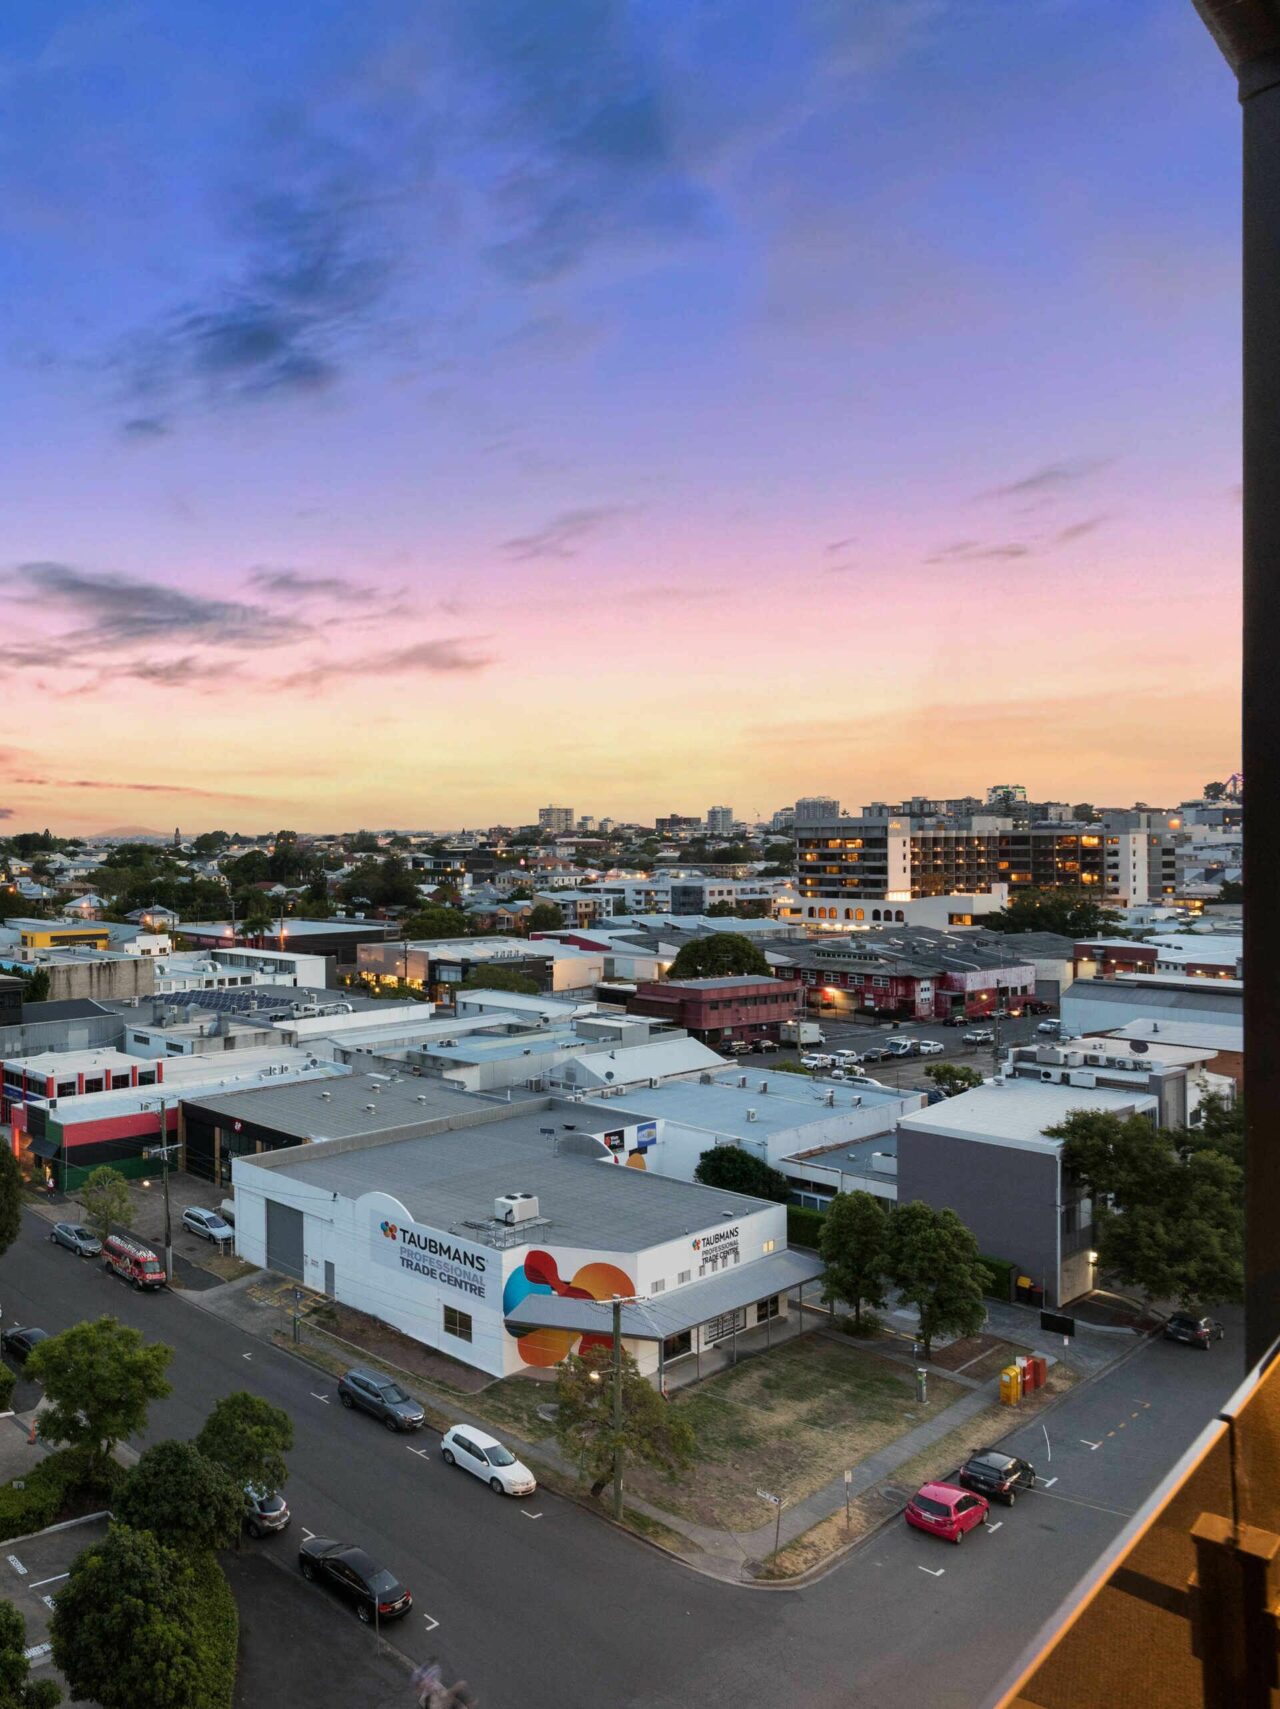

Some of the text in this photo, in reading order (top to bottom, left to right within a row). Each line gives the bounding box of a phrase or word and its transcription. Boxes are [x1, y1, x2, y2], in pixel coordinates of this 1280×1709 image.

[399, 1228, 486, 1272] TAUBMANS
[702, 1227, 739, 1248] TAUBMANS
[702, 1239, 739, 1256] PROFESSIONAL
[399, 1247, 486, 1286] PROFESSIONAL
[702, 1246, 739, 1265] TRADE CENTRE
[399, 1256, 486, 1298] TRADE CENTRE
